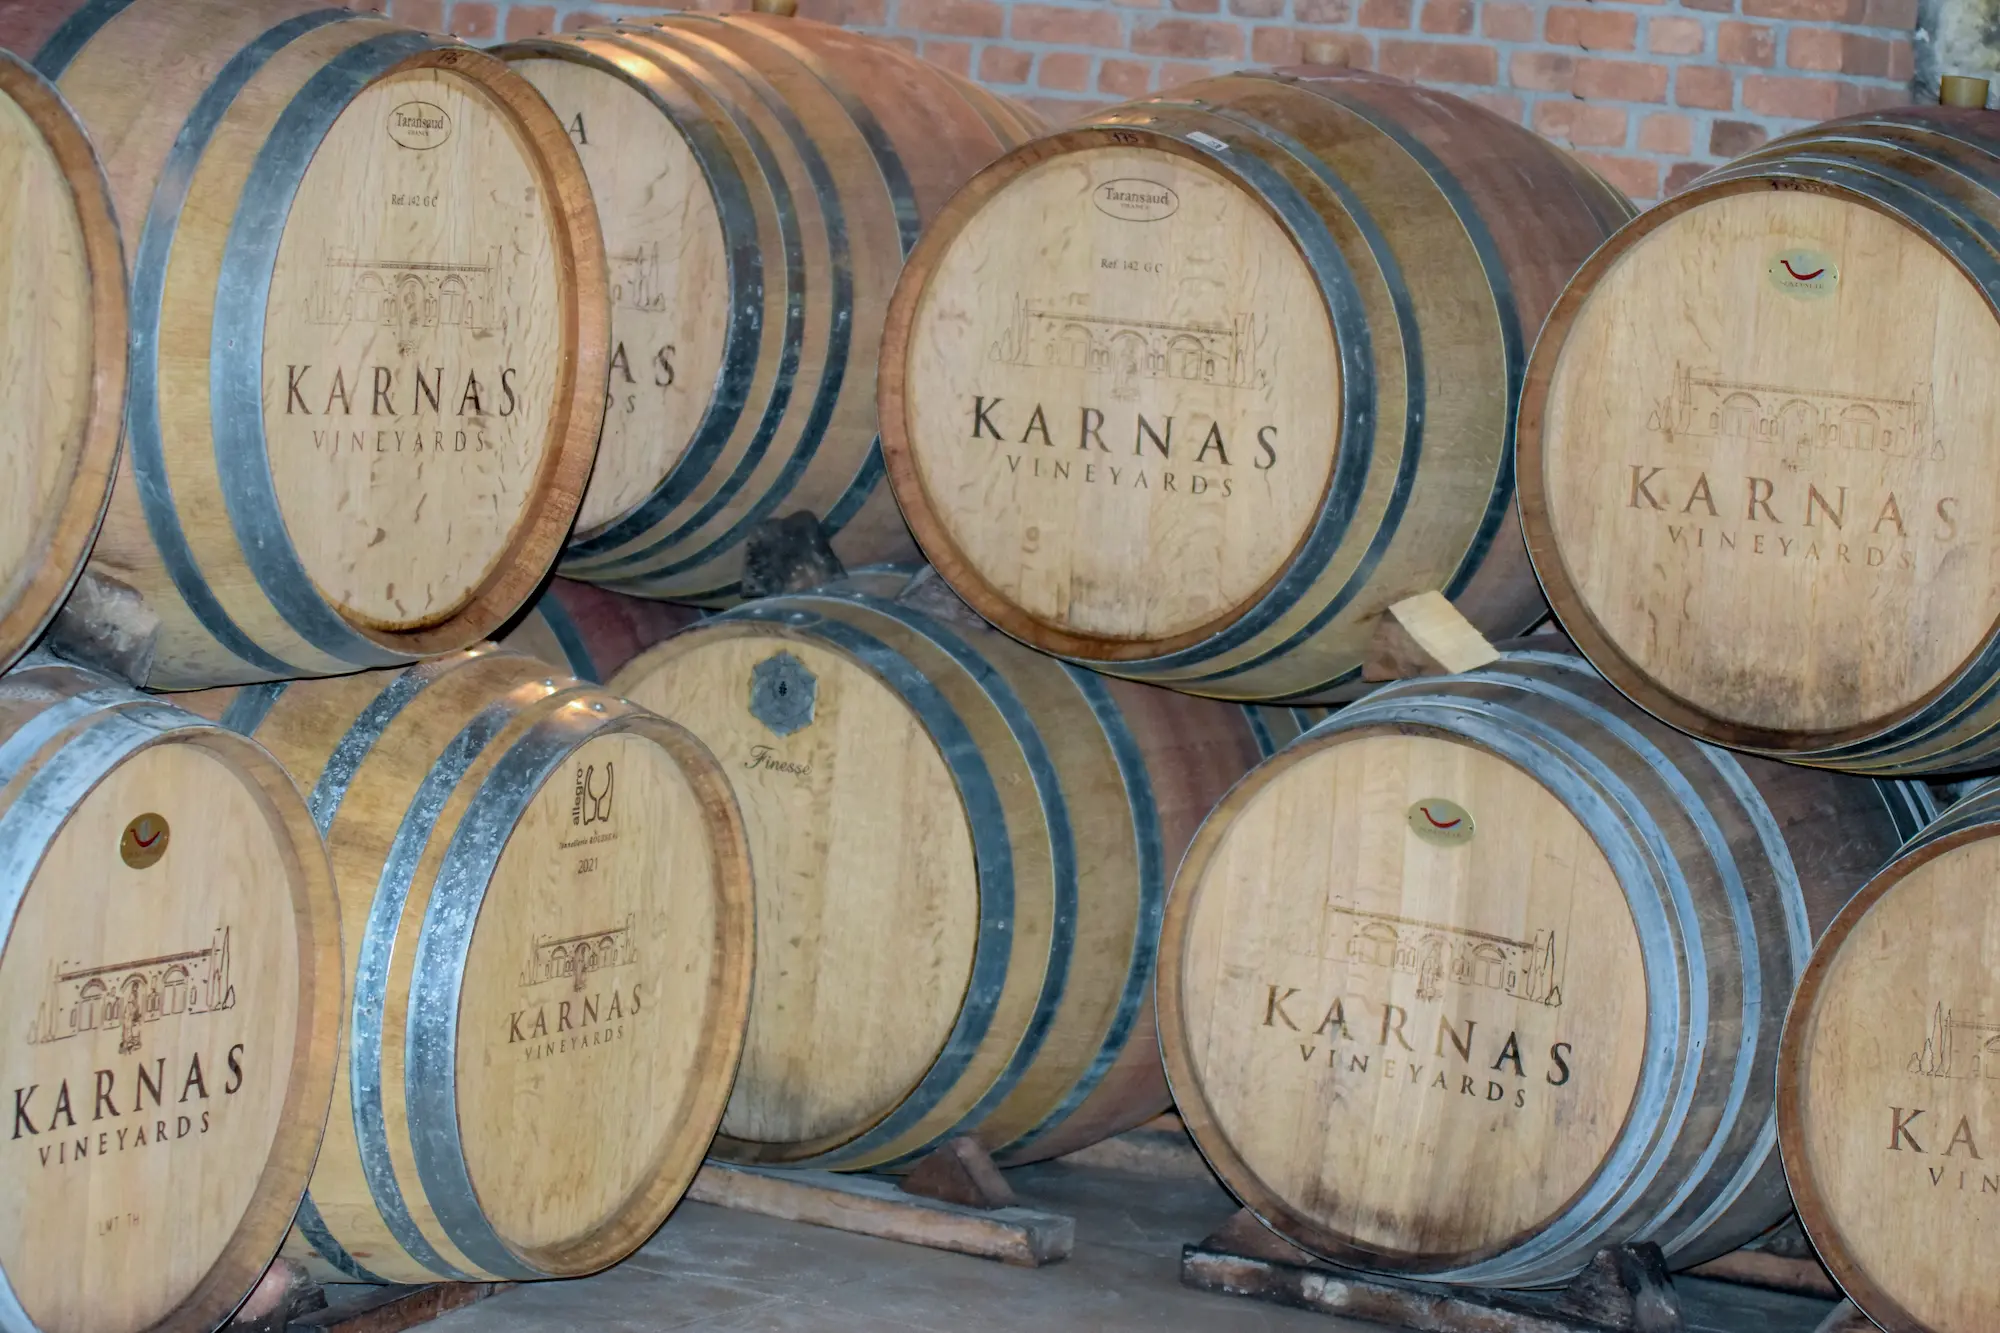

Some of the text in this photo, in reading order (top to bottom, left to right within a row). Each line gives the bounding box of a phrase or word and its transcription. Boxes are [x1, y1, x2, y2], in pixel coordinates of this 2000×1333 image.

[396, 112, 444, 130] Taransaud
[1105, 187, 1169, 206] Taransaud
[1124, 260, 1139, 271] 142
[286, 364, 516, 418] KARNAS
[312, 430, 485, 453] VINEYARDS
[970, 395, 1279, 470] KARNAS
[1006, 454, 1233, 498] VINEYARDS
[1626, 464, 1959, 542] KARNAS
[1667, 524, 1913, 571] VINEYARDS
[744, 744, 812, 776] Finesse
[572, 768, 584, 826] allegro
[577, 857, 599, 874] 2021
[508, 983, 642, 1044] KARNAS
[1263, 983, 1573, 1087] KARNAS
[525, 1025, 624, 1061] VINEYARDS
[11, 1043, 244, 1140] KARNAS
[1299, 1044, 1526, 1109] VINEYARDS
[38, 1111, 210, 1168] VINEYARDS
[1886, 1106, 1984, 1160] KA
[1928, 1166, 2000, 1195] VIN
